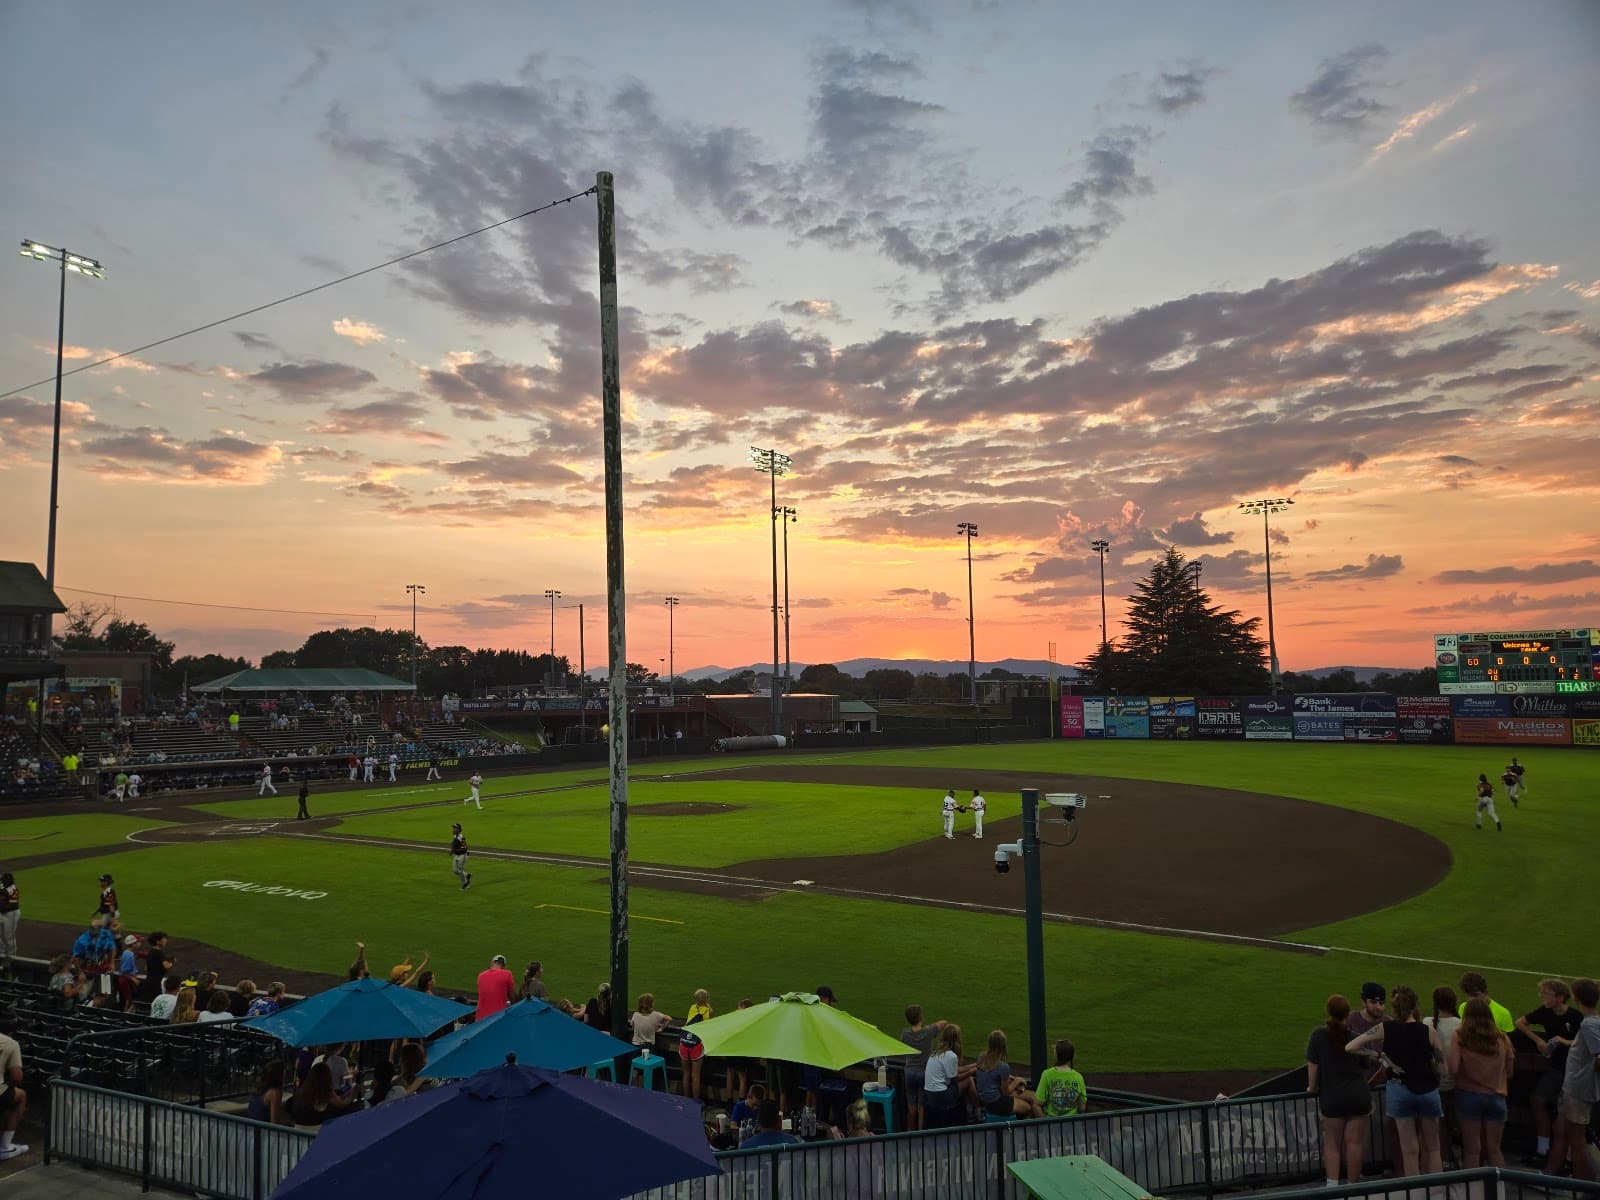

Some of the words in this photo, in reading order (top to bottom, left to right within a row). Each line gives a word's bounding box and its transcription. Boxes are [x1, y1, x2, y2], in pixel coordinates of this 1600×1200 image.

[1489, 632, 1554, 641] COLEMAN-ADAMS
[1513, 696, 1568, 712] Whitten
[1498, 721, 1565, 730] Maddox
